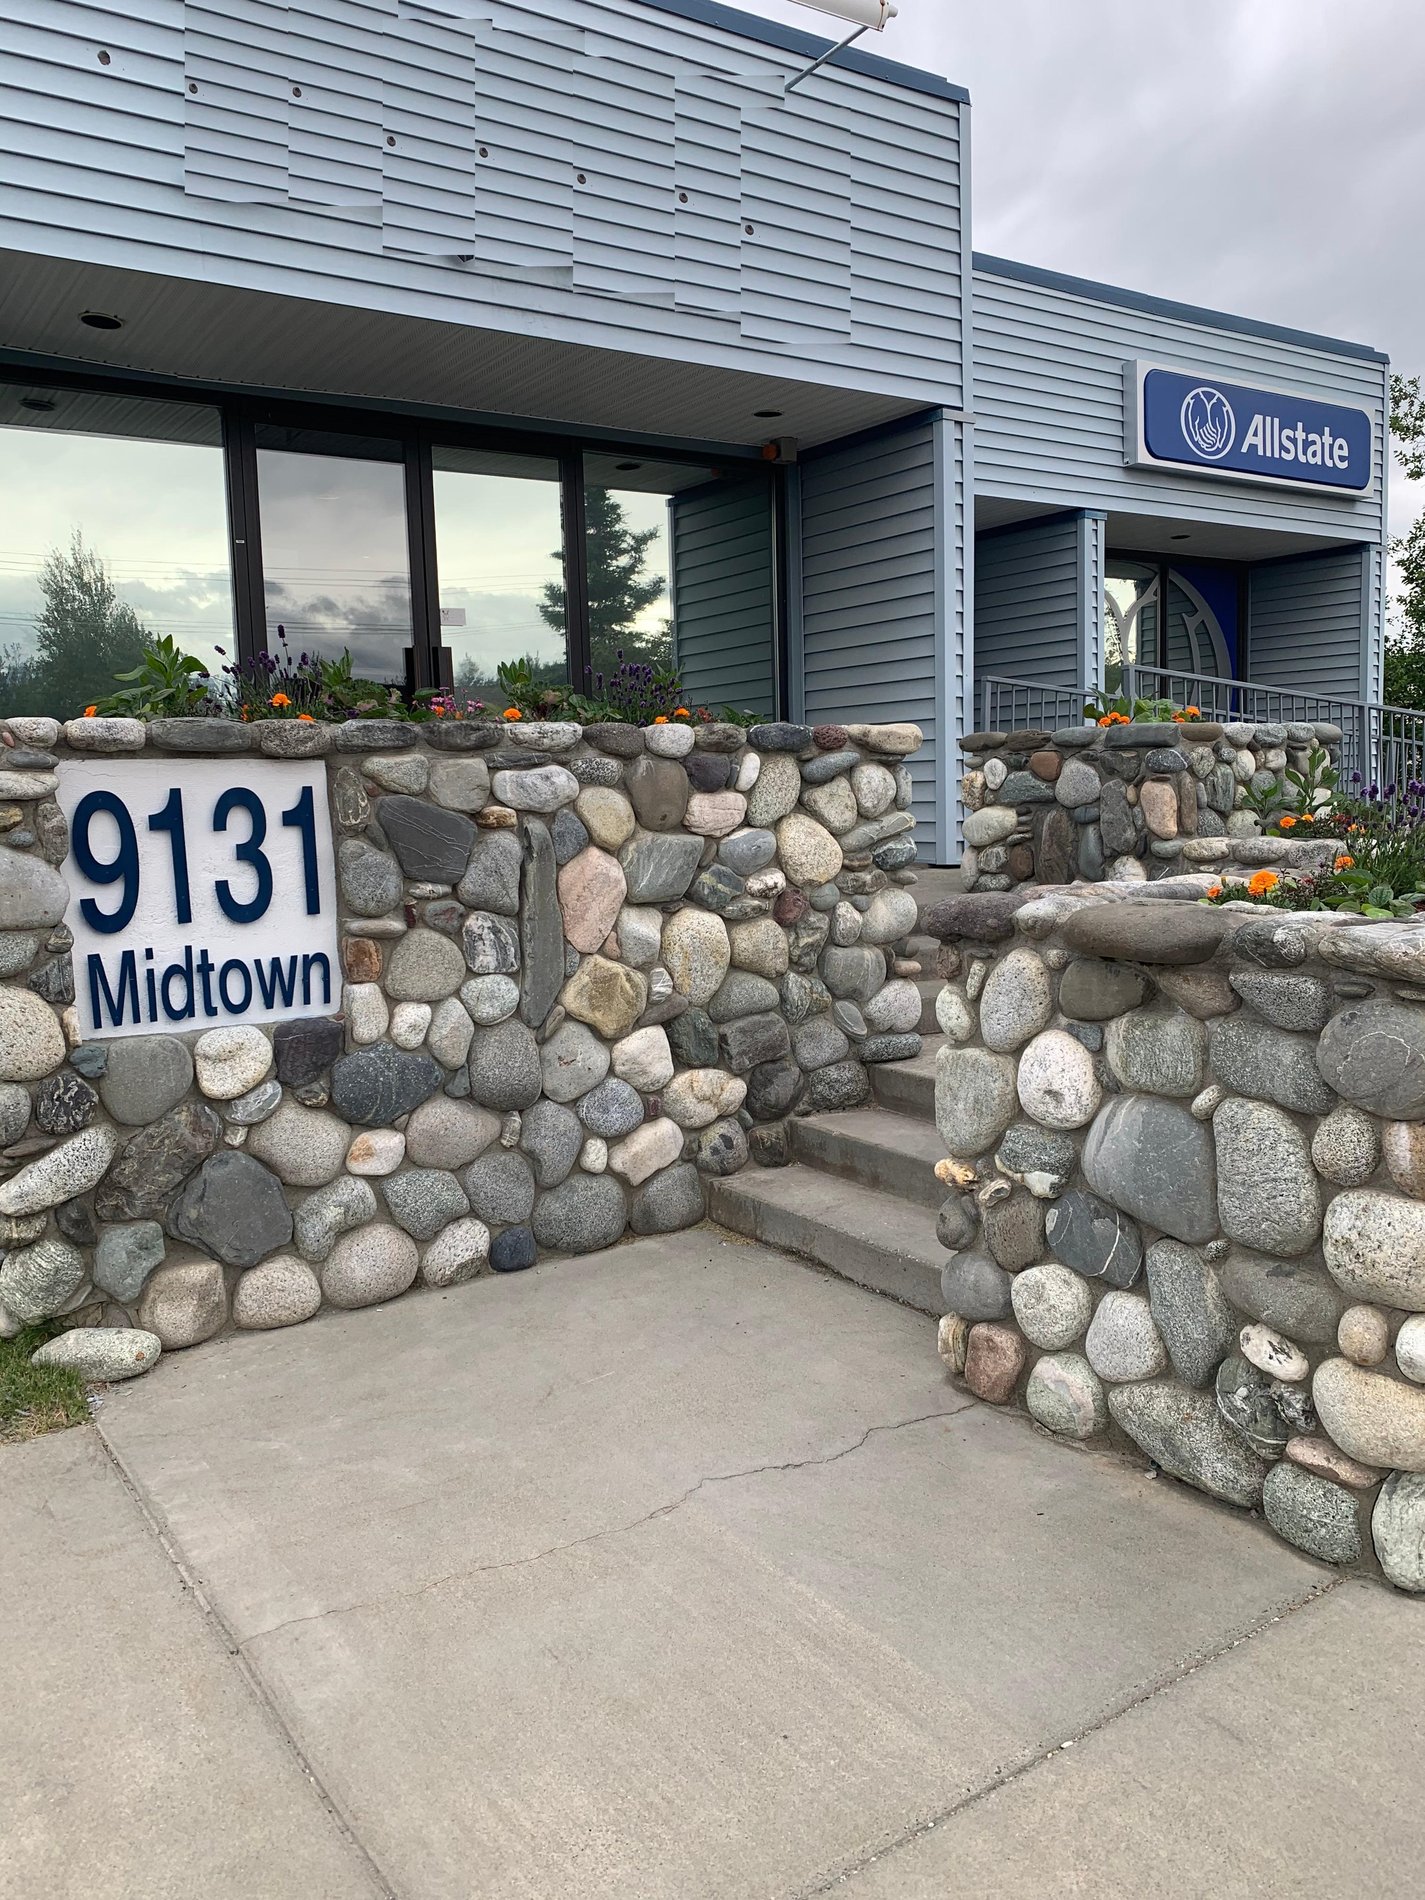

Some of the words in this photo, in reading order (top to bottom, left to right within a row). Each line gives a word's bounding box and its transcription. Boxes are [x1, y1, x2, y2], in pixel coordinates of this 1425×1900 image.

[1241, 414, 1349, 469] Allstate
[72, 785, 321, 934] 9131
[87, 945, 331, 1029] Midtown
